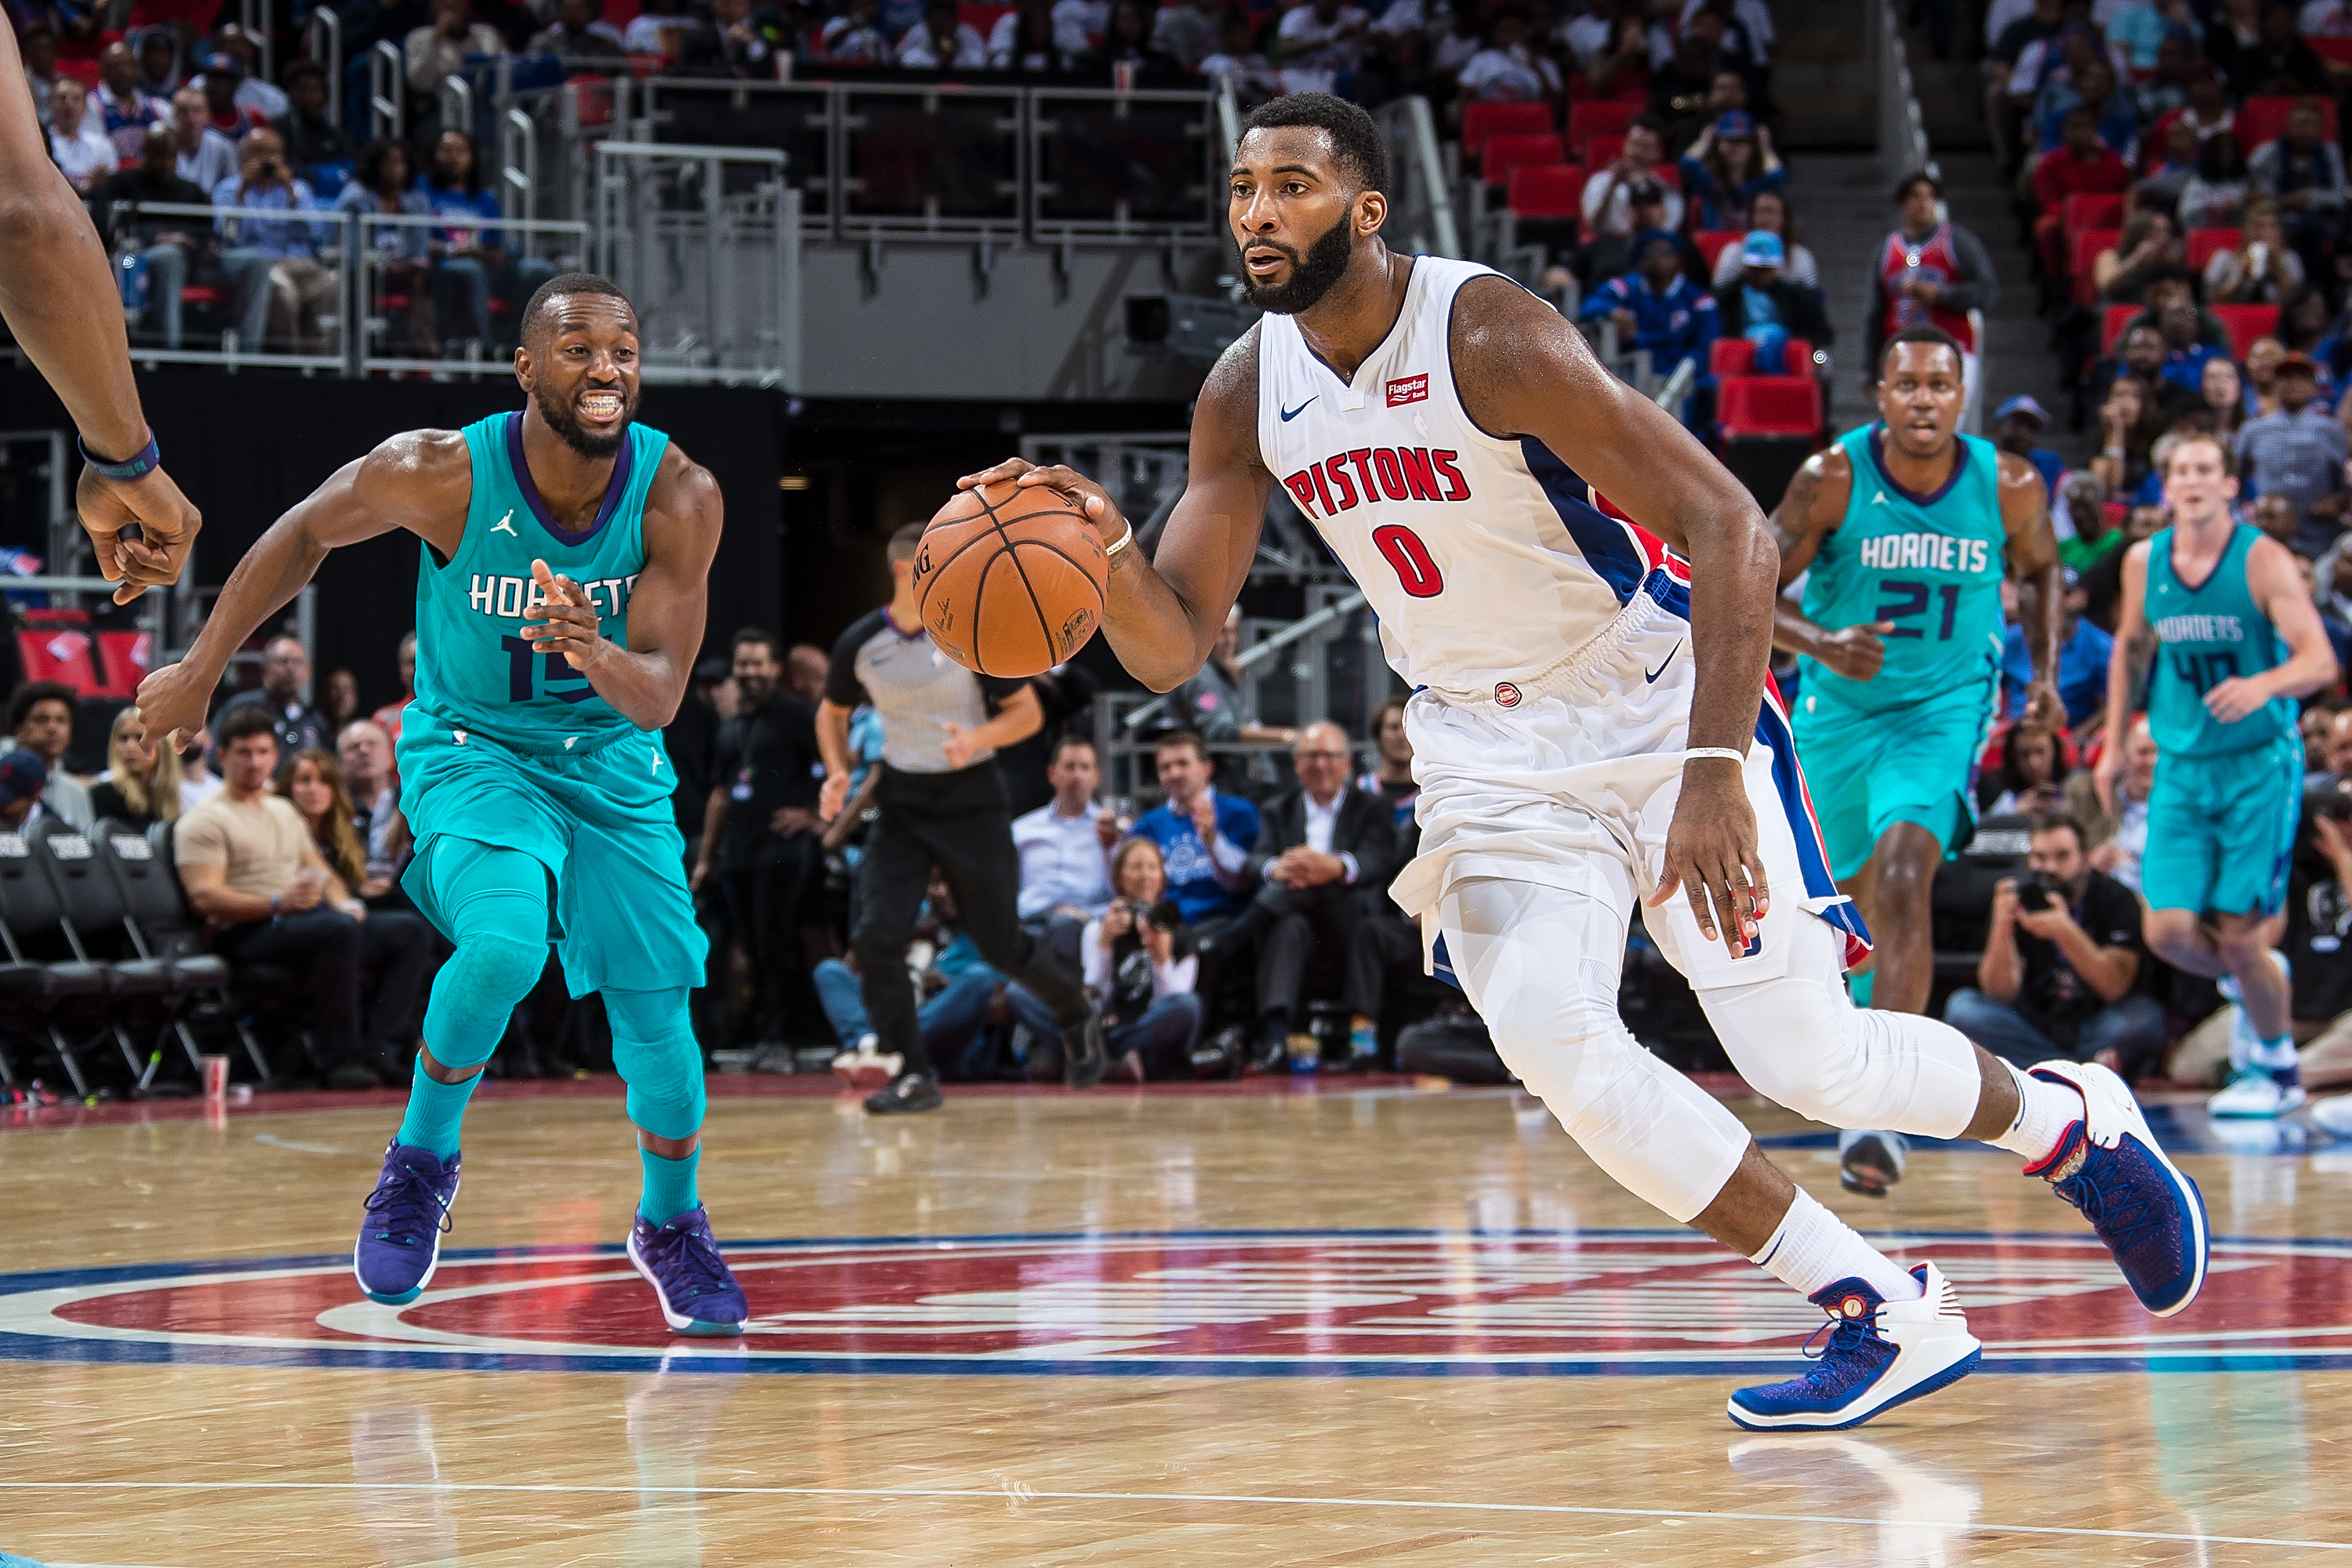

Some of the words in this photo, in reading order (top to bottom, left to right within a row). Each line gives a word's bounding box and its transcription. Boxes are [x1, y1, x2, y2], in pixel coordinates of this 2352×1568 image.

[1388, 379, 1427, 395] Flagstar
[1282, 446, 1472, 520] PISTONS
[1372, 524, 1444, 598] 0
[1860, 533, 1989, 573] HORNETS
[1875, 580, 1962, 641] 21
